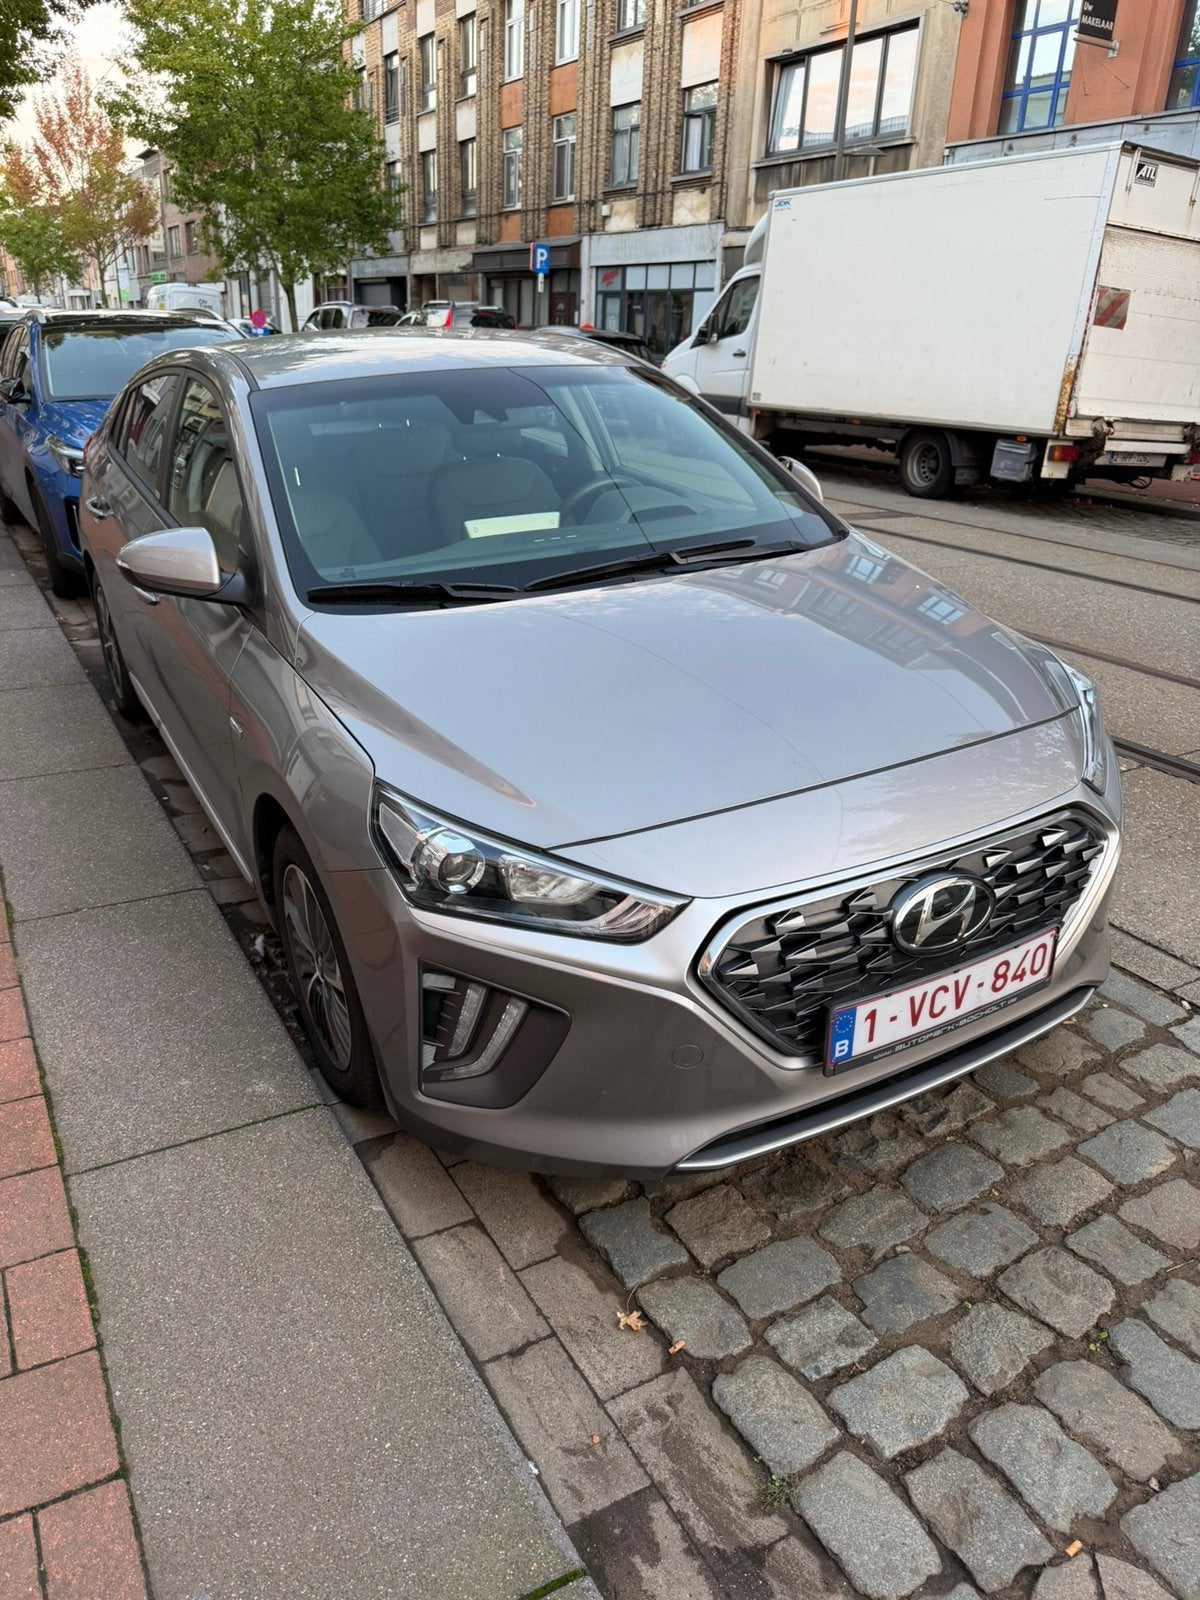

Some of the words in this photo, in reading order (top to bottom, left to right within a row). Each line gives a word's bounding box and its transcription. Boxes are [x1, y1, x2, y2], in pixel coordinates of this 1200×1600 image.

[1083, 1, 1094, 11] Uw
[1081, 14, 1113, 30] MAKELAAR
[1136, 165, 1156, 179] ATL
[536, 248, 548, 269] P
[864, 942, 1047, 1043] 1-VCV-840
[835, 1039, 849, 1058] B
